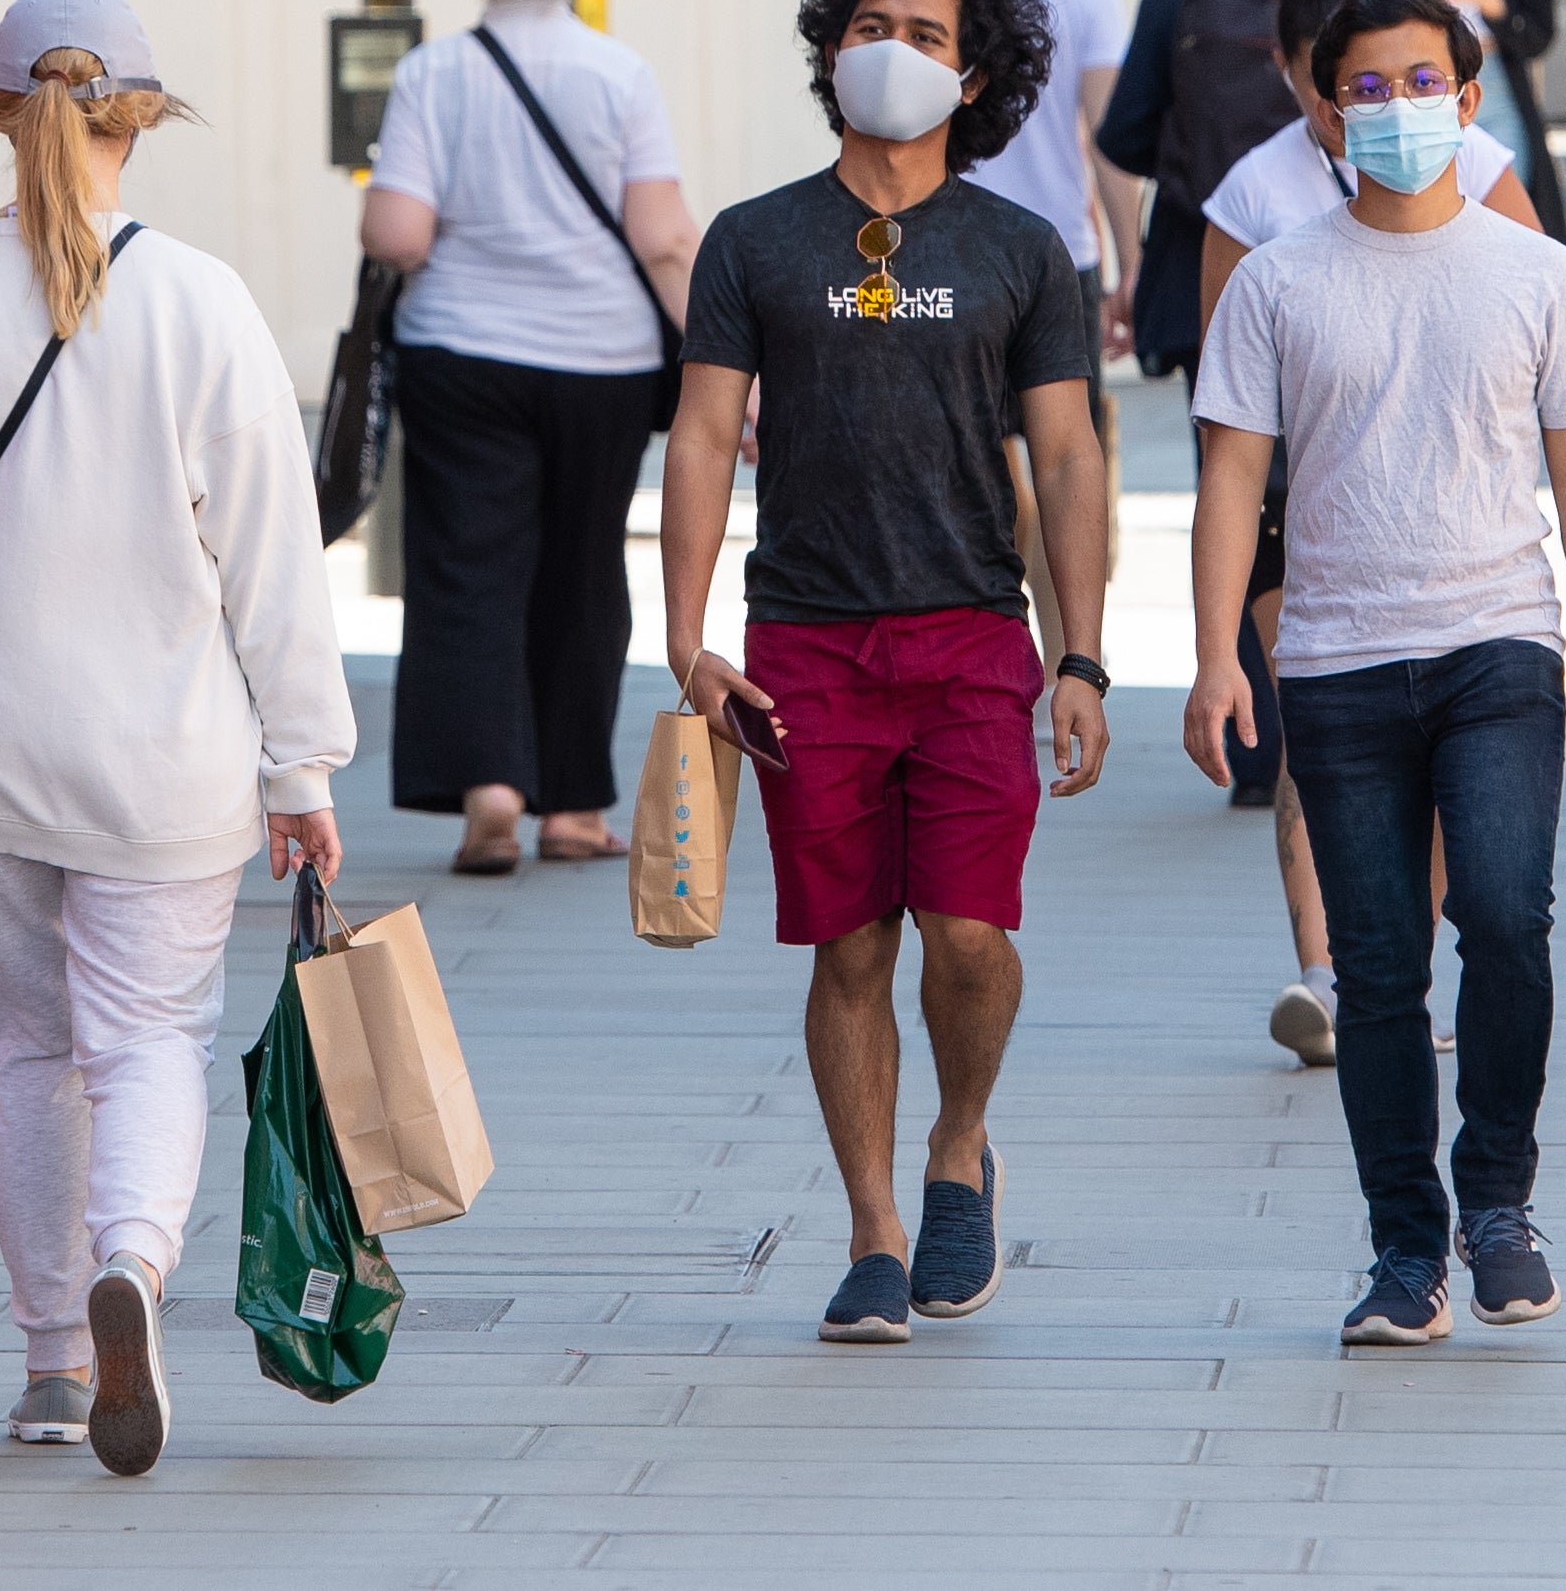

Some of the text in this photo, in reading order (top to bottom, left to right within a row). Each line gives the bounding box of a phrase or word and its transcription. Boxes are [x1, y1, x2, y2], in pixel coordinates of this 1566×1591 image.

[828, 286, 953, 303] LONG LIVE
[828, 302, 953, 319] THE KING
